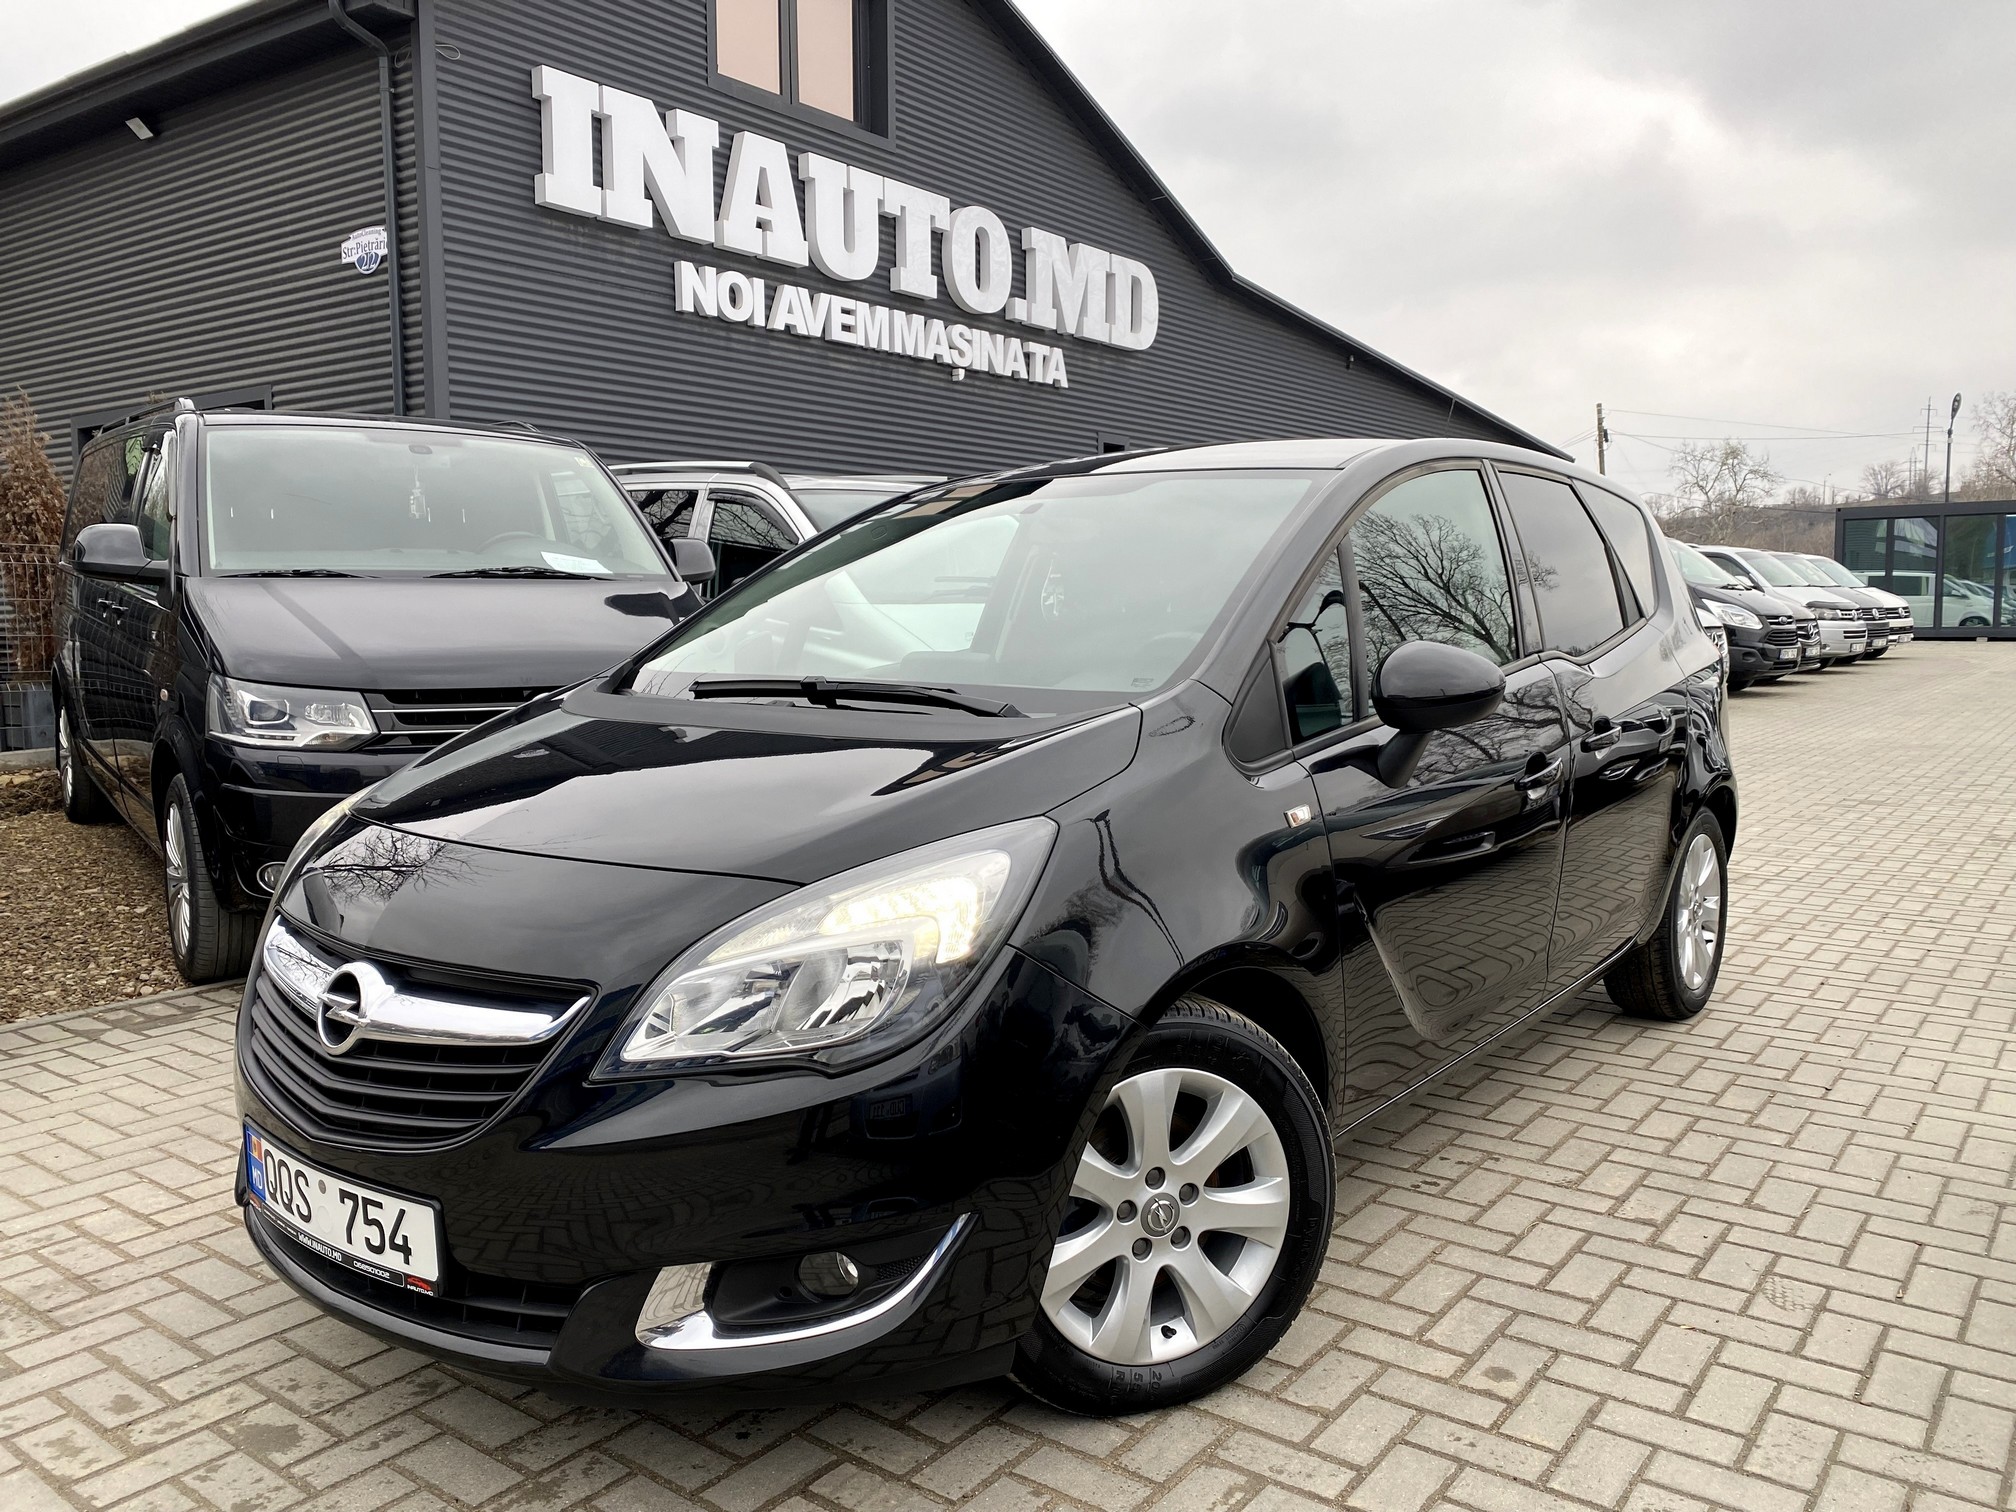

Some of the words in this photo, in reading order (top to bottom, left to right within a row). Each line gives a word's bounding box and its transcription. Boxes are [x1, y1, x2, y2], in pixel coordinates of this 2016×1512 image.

[532, 65, 1159, 351] INAUTO.MD
[361, 253, 376, 270] 22
[674, 260, 766, 328] NOI
[252, 1165, 263, 1190] MD
[264, 1148, 312, 1223] QQS
[338, 1187, 413, 1266] 754
